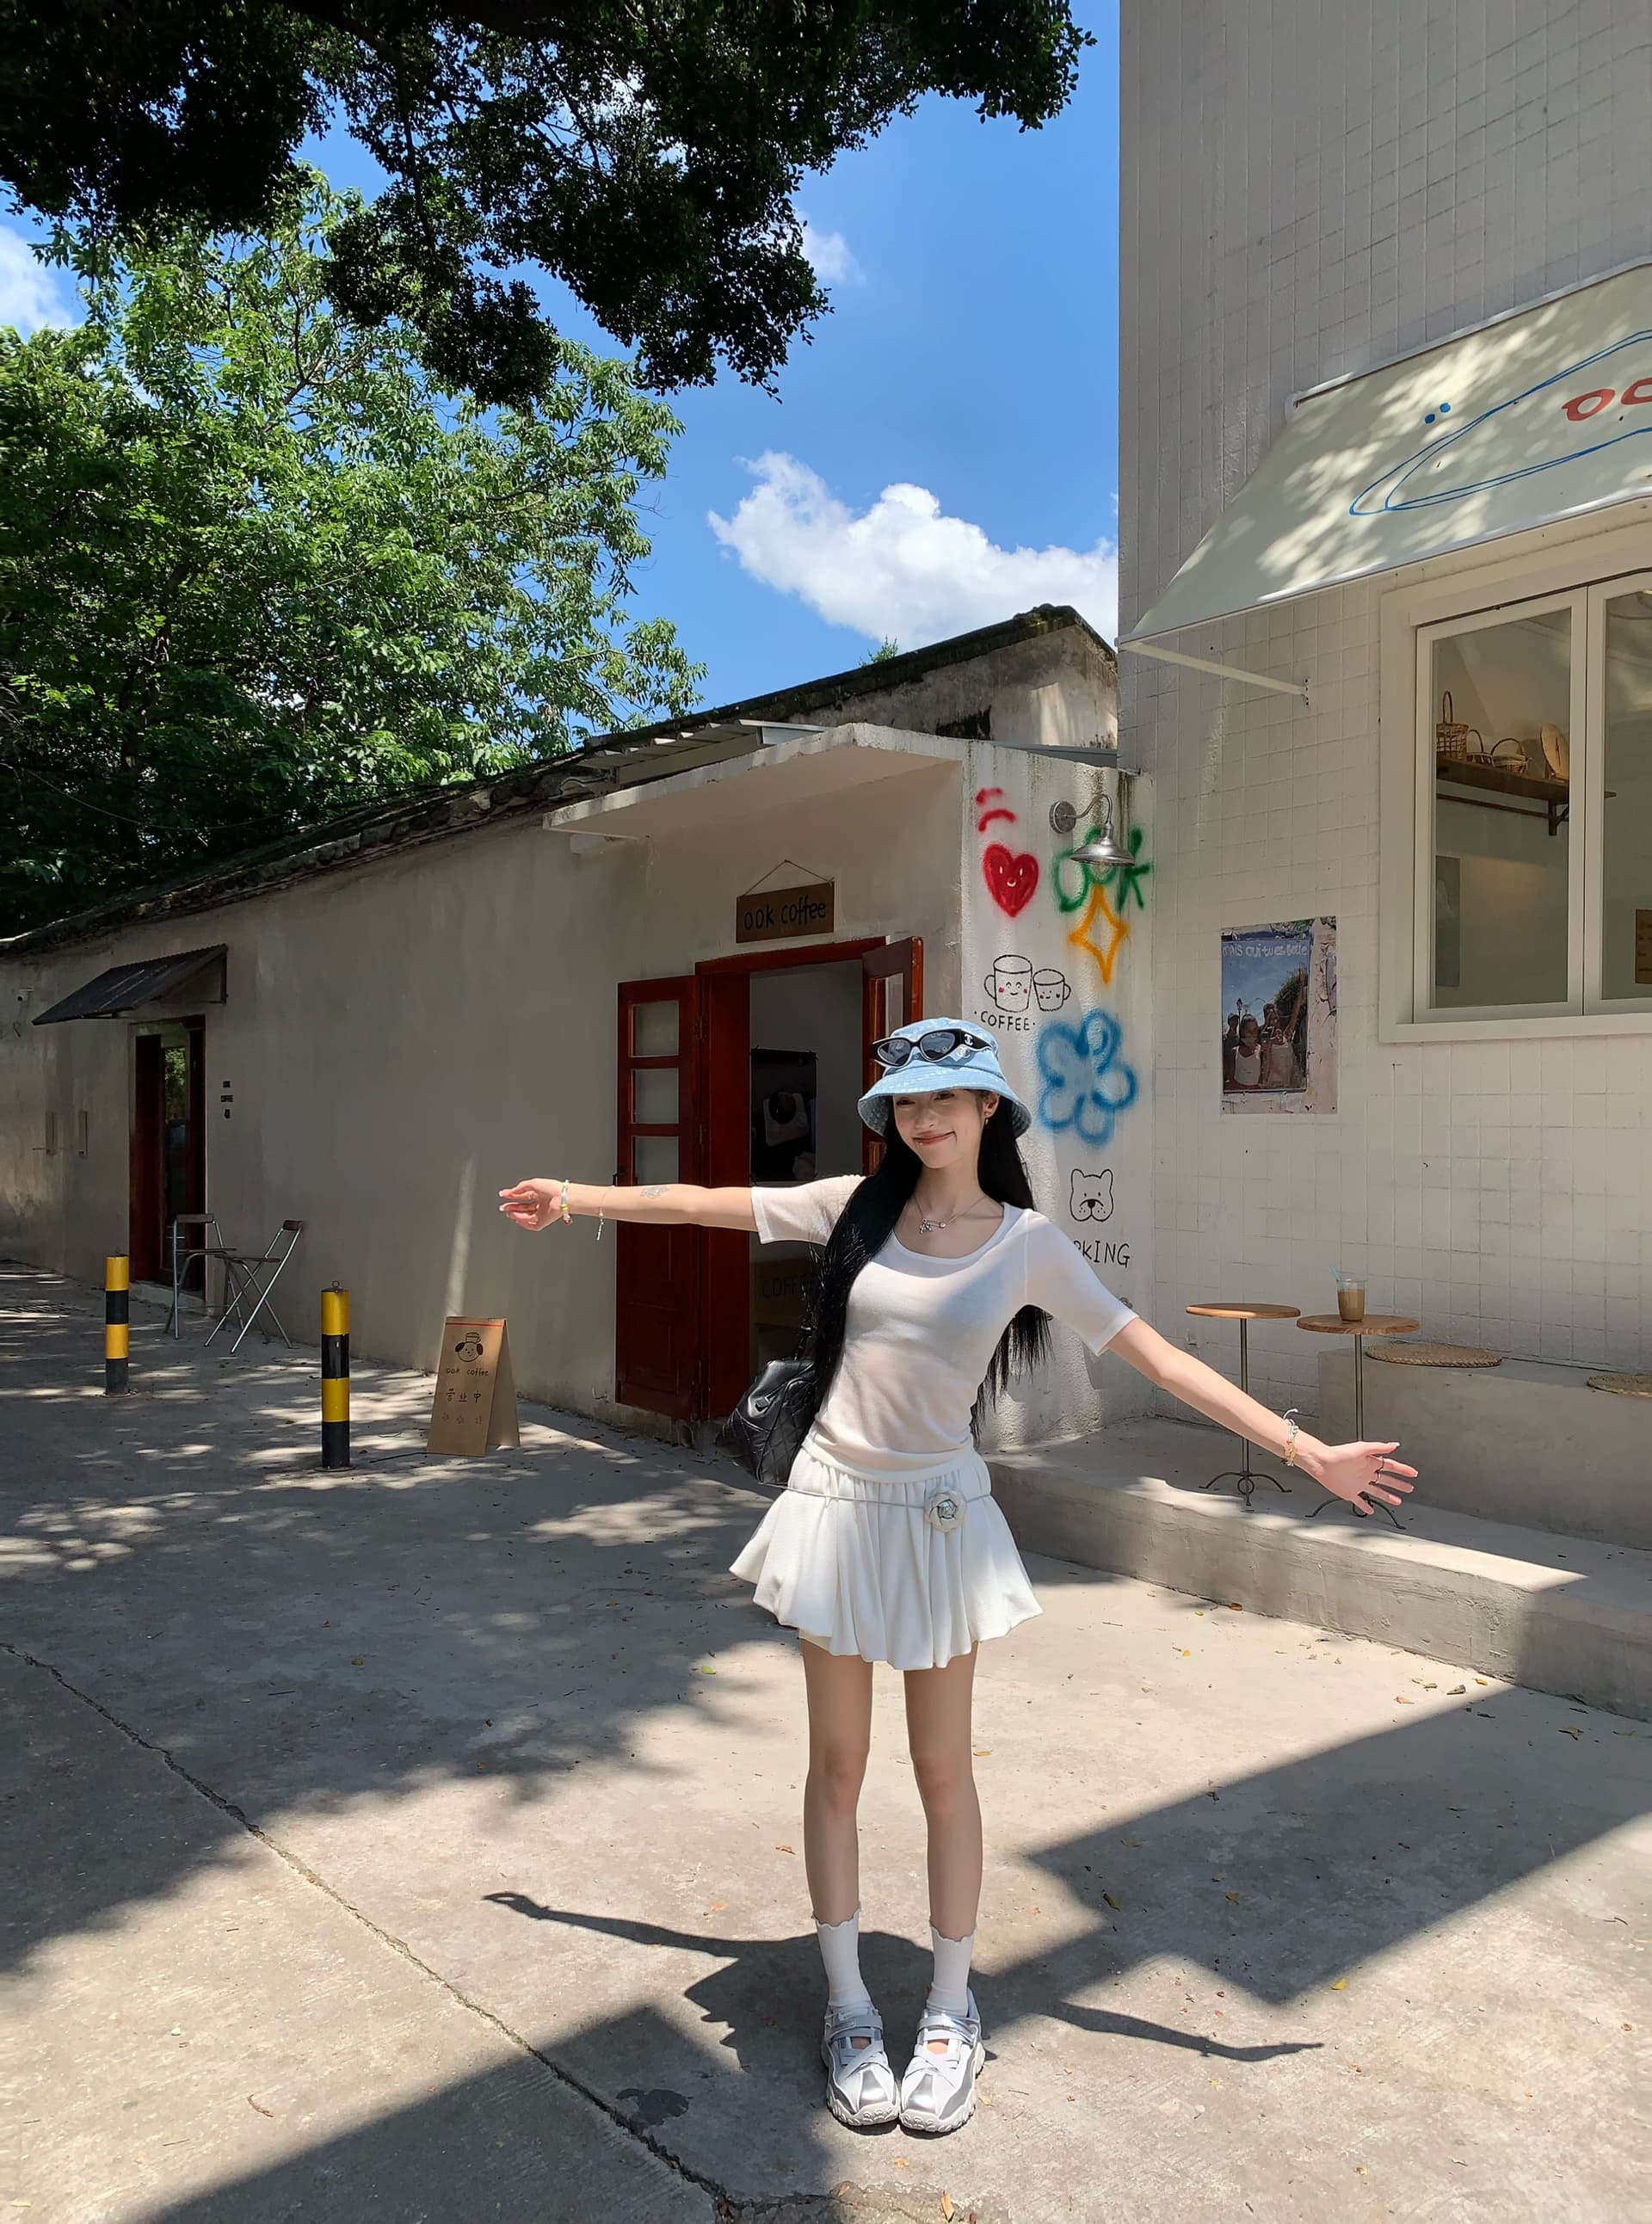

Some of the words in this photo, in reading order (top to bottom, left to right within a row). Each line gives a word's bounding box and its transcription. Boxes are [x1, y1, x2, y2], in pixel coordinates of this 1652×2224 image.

[780, 895, 827, 925] coffee
[981, 1010, 1030, 1031] COFFEE
[466, 1367, 489, 1377] coffee
